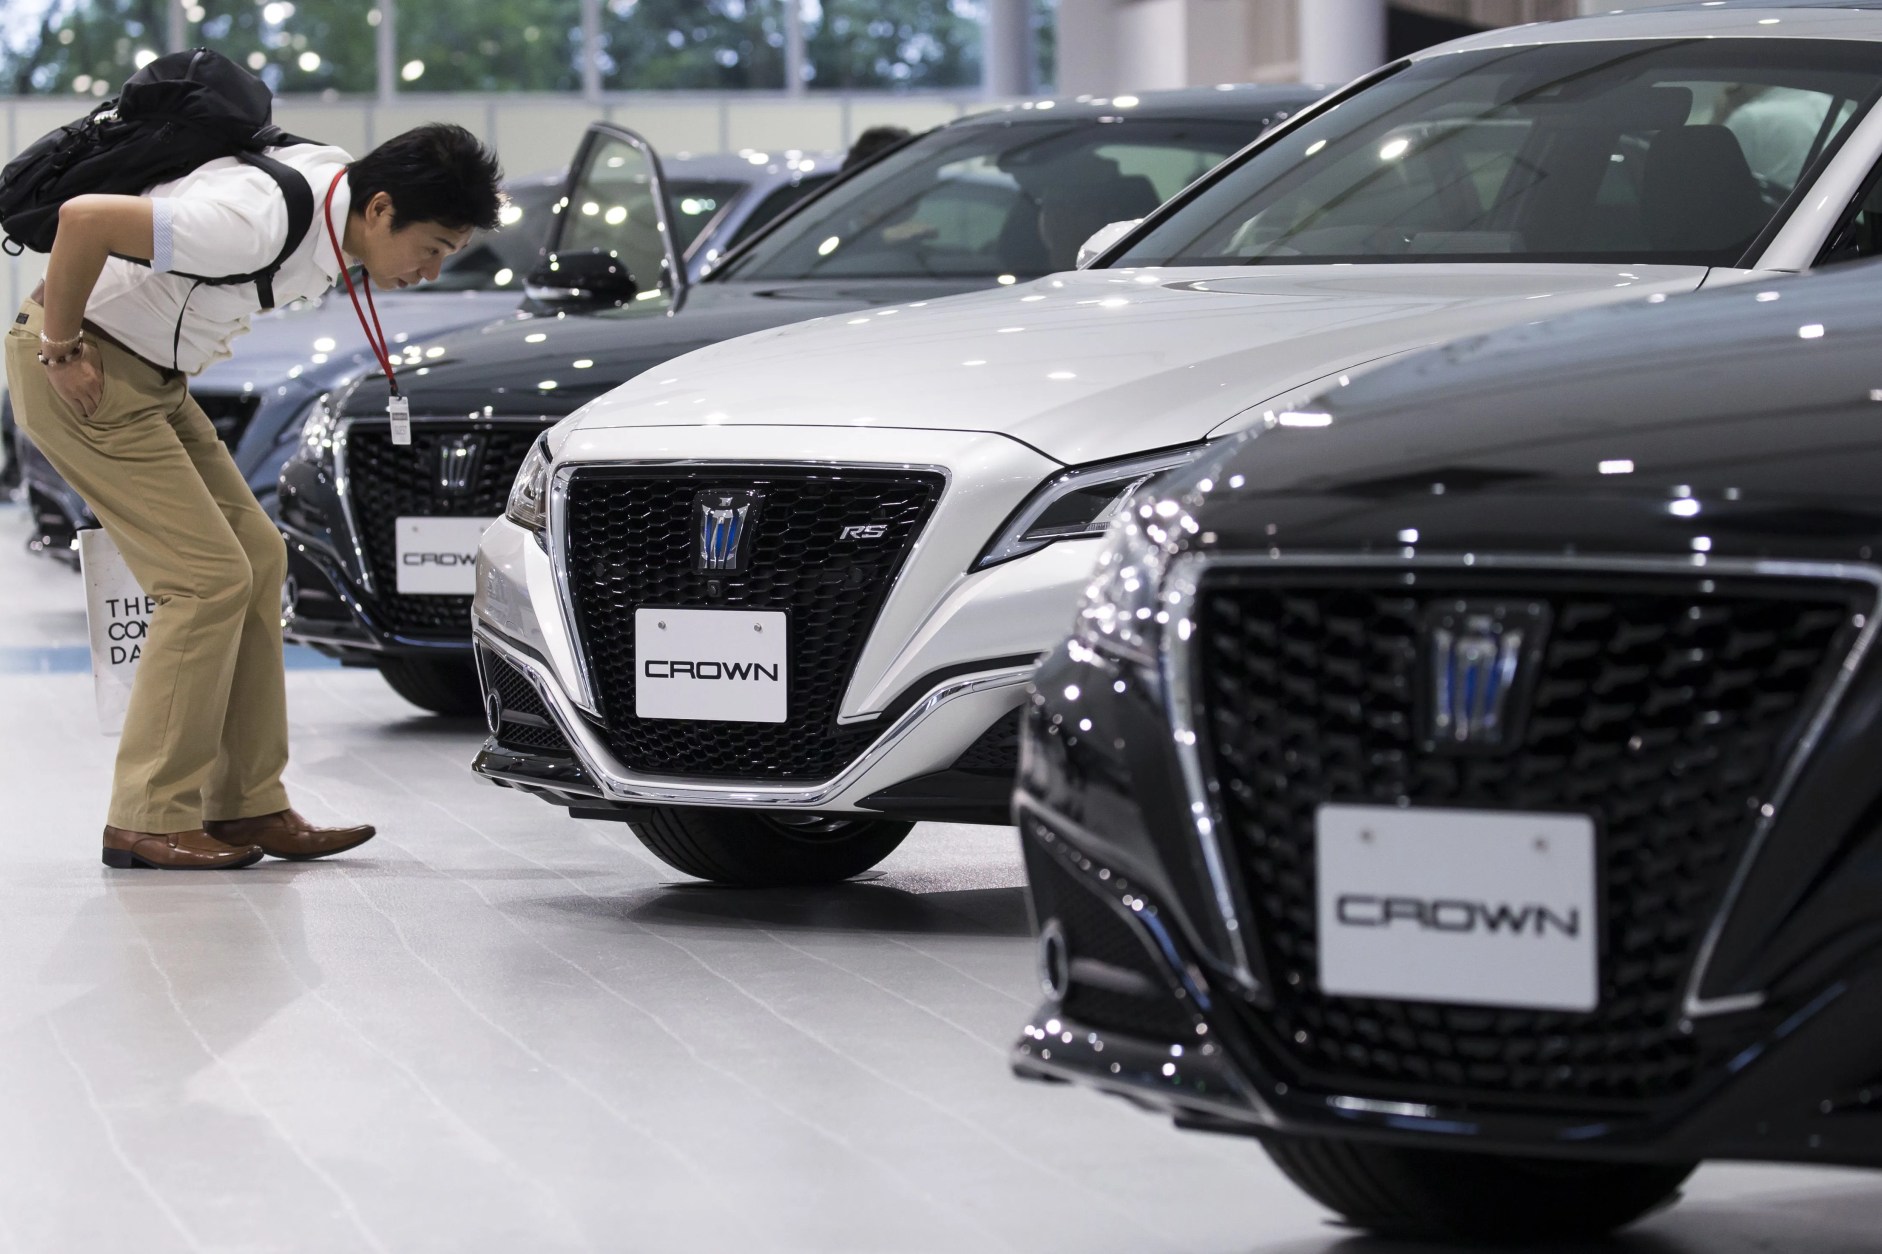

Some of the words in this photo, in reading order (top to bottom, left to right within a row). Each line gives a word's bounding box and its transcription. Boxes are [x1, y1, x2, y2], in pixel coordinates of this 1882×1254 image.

[840, 525, 888, 540] RS
[105, 596, 156, 618] THE
[645, 660, 778, 681] CROWN
[1337, 894, 1579, 939] CROWN
